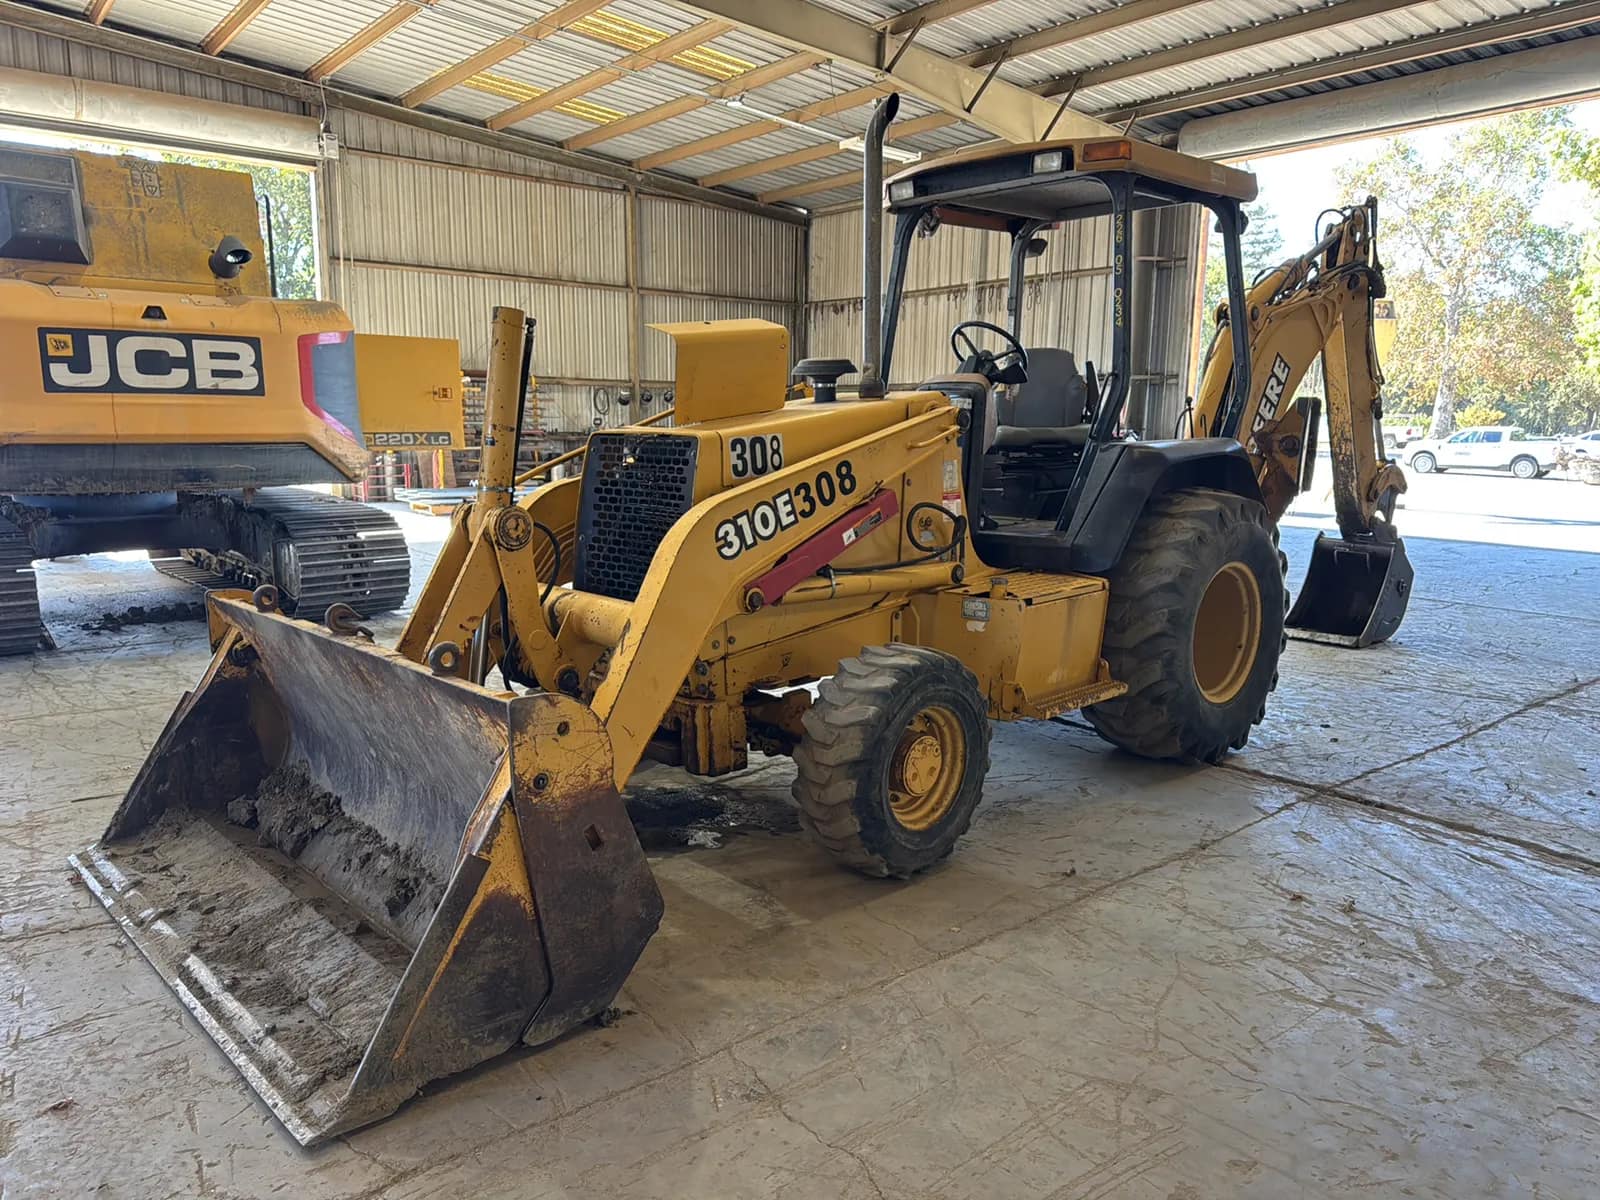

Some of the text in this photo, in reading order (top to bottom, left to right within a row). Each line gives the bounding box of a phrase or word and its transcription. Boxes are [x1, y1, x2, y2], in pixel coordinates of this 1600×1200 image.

[1115, 254, 1124, 275] 05
[49, 335, 259, 390] JCB
[1252, 353, 1290, 433] EERE
[431, 436, 449, 445] LC
[731, 436, 783, 477] 308
[715, 489, 797, 560] 310E
[795, 460, 857, 518] 308
